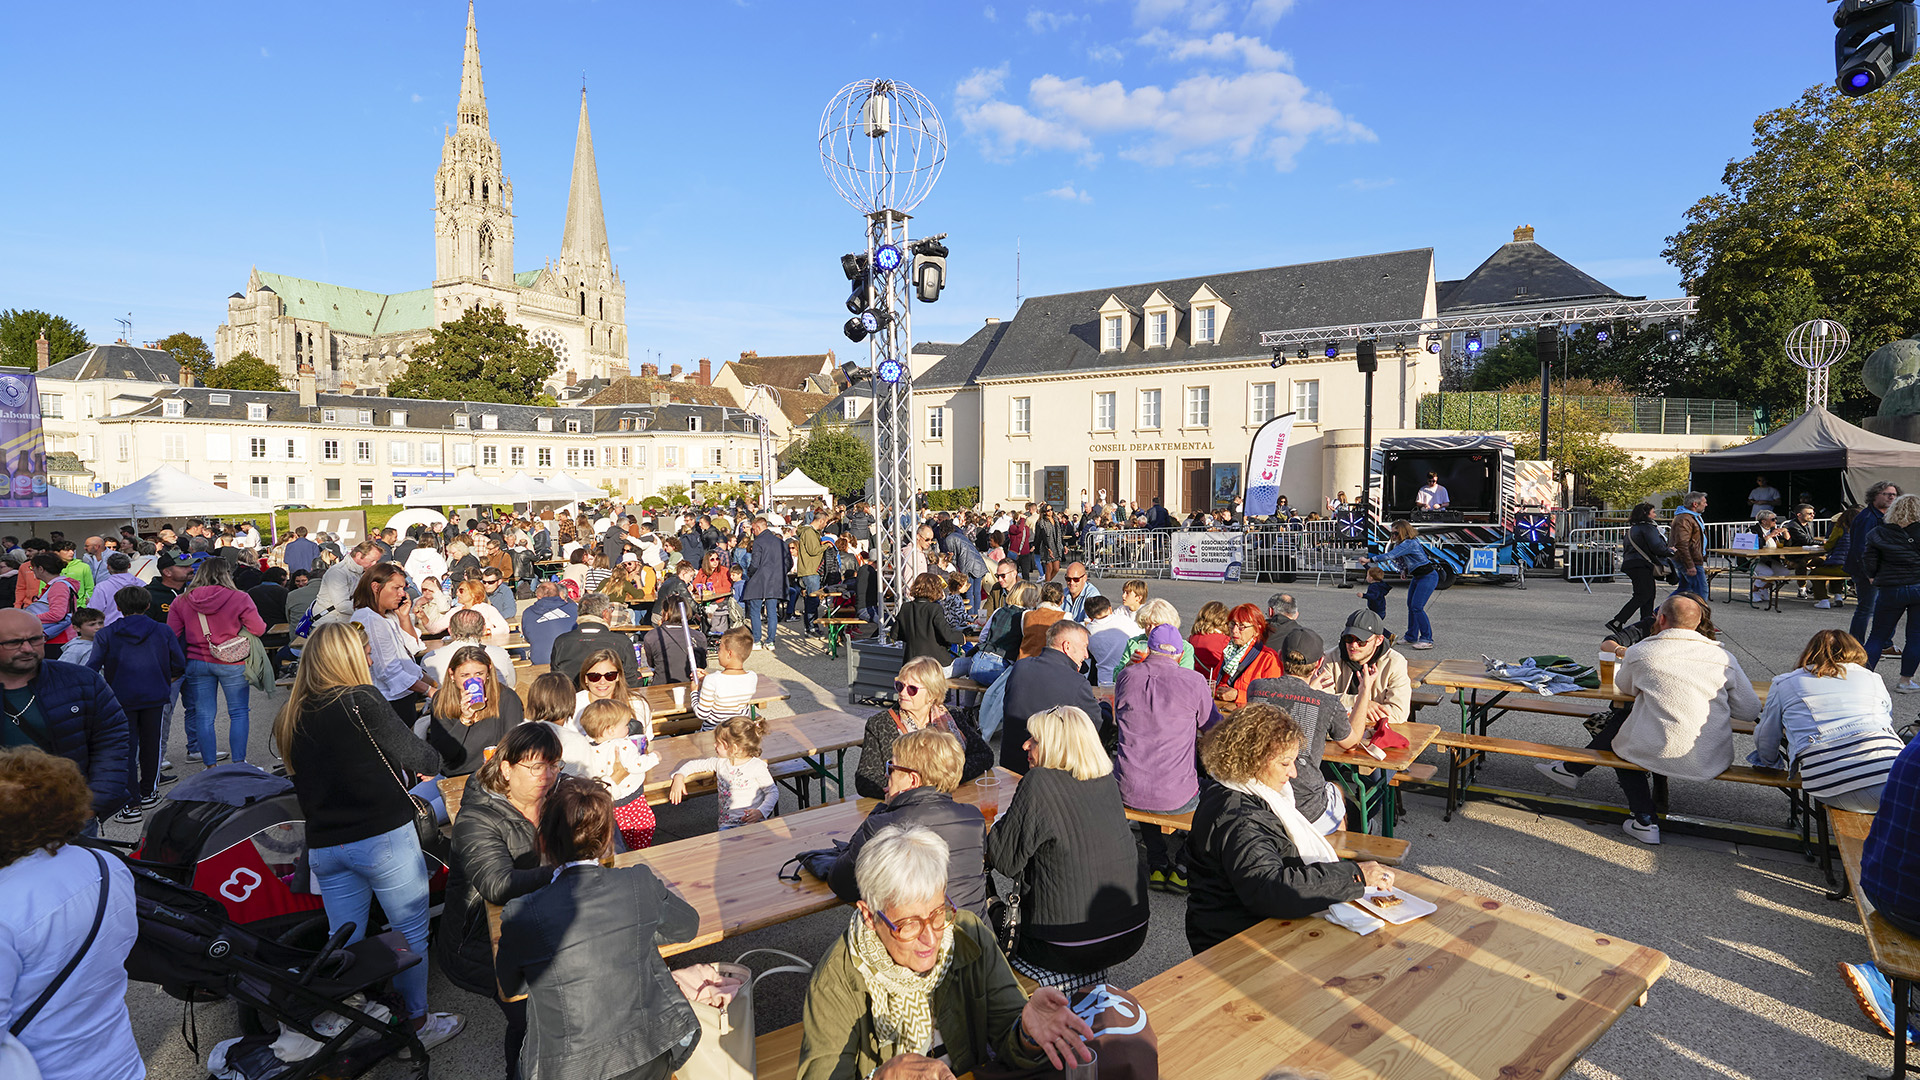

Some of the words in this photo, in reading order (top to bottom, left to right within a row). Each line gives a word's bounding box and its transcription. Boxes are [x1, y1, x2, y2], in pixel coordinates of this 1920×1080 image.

[1089, 444, 1127, 452] CONSEIL
[1130, 442, 1215, 451] DEPARTEMENTAL
[1273, 433, 1285, 467] VITRINES
[95, 483, 102, 491] P
[1285, 694, 1320, 705] SPHERES
